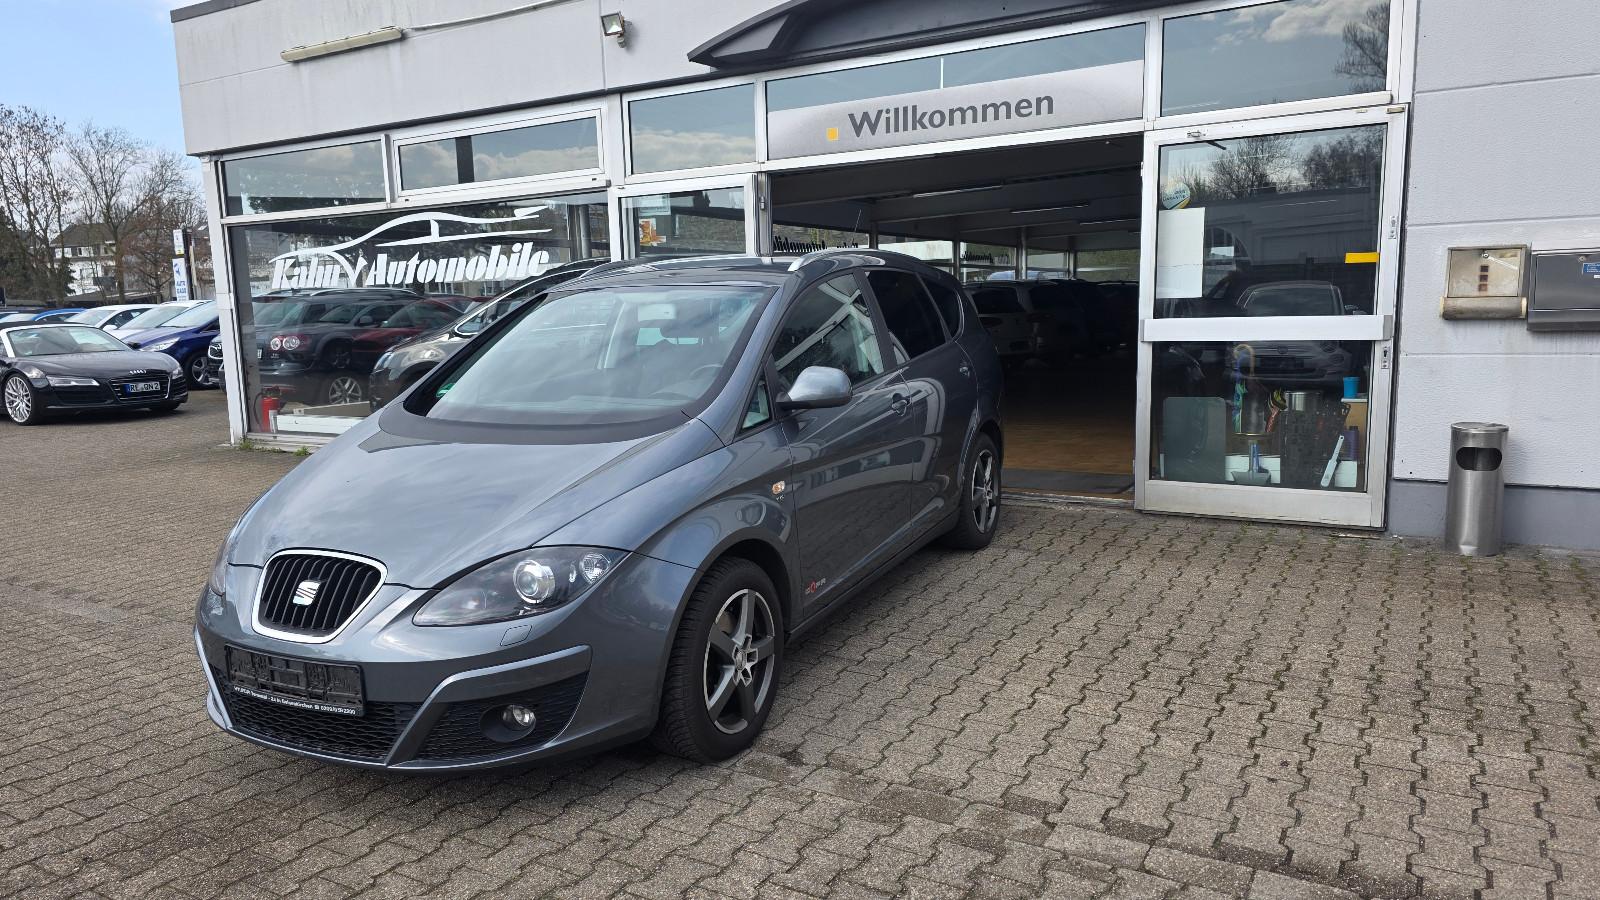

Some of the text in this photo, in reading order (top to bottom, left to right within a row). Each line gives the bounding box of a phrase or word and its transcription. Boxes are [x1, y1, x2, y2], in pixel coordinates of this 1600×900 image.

[848, 95, 1054, 138] Willkommen
[272, 242, 550, 289] Kahn Automobile
